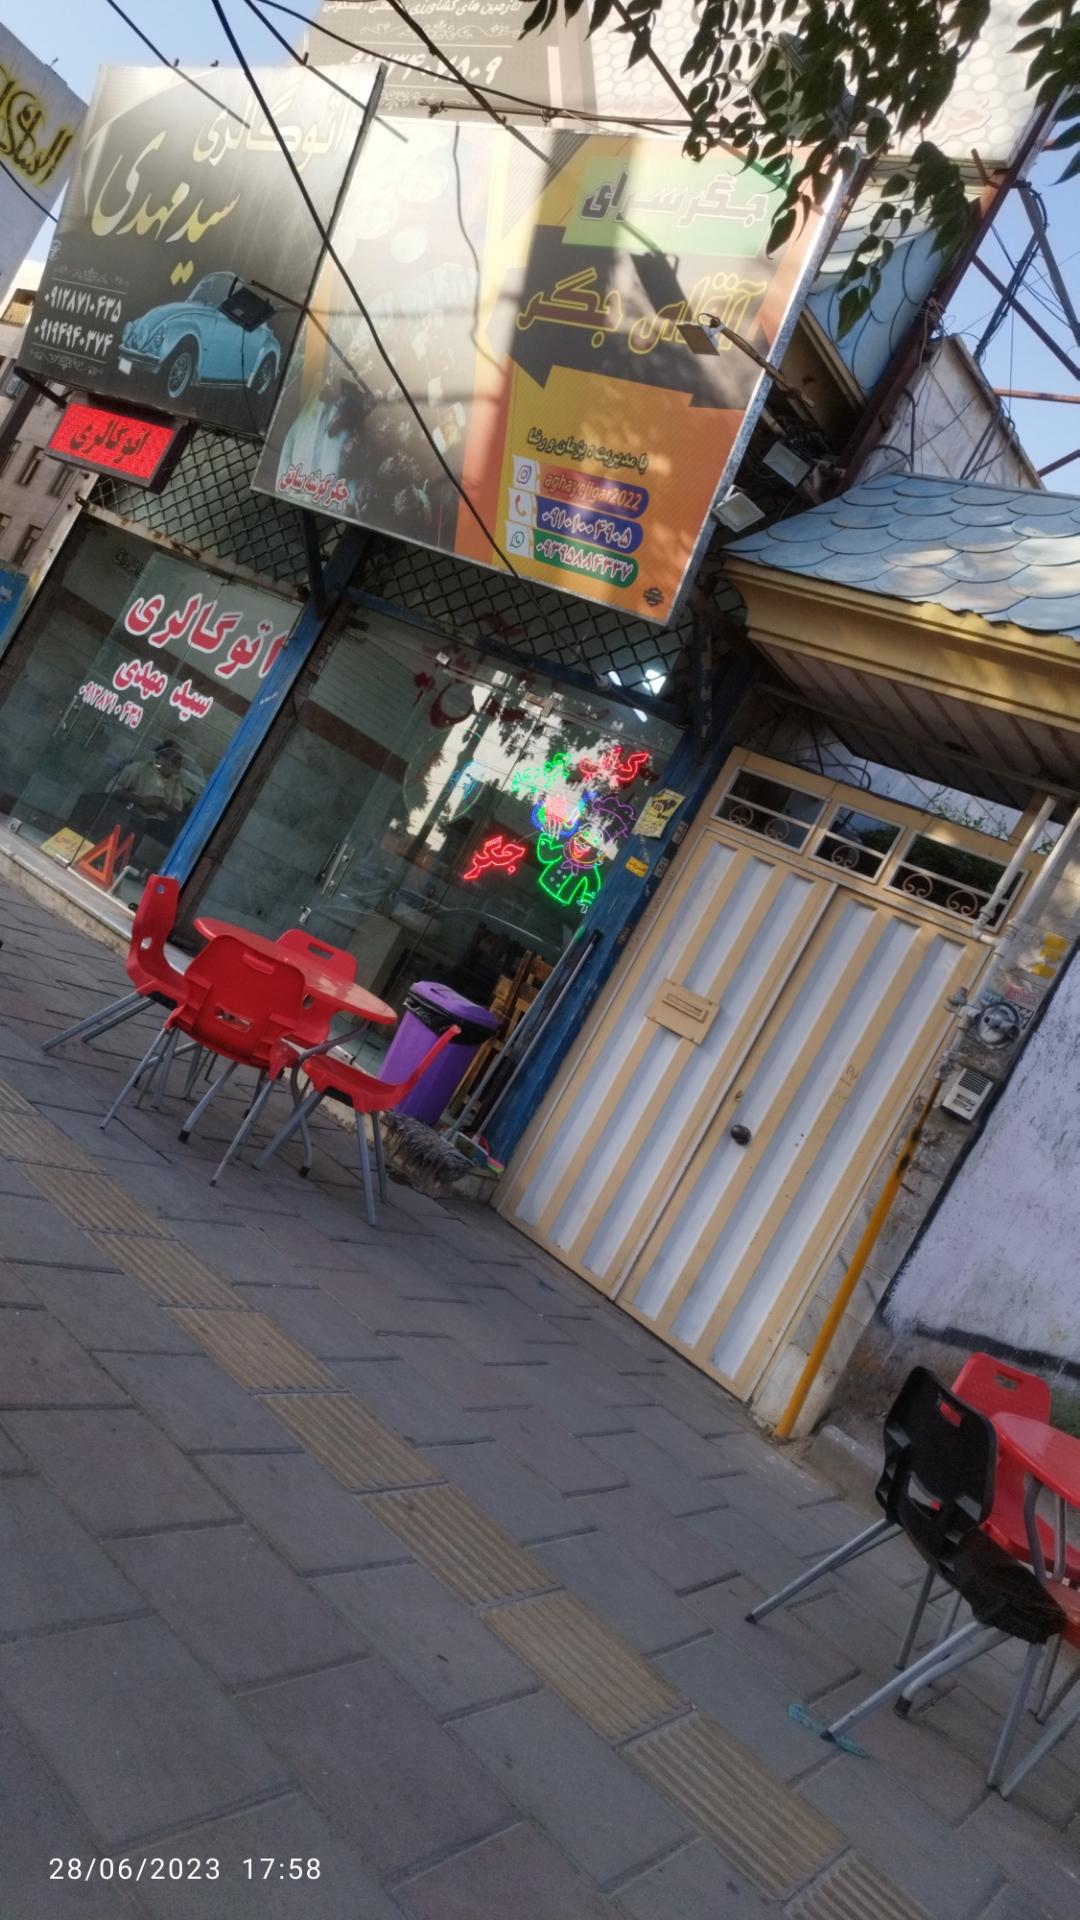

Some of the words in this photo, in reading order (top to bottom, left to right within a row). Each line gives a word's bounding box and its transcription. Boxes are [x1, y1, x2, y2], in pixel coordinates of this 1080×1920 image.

[91, 130, 190, 241] مهدی
[165, 192, 241, 286] سید
[515, 266, 624, 348] جگر
[112, 659, 168, 700] مهدی
[169, 678, 214, 721] سید
[463, 836, 526, 879] جگر
